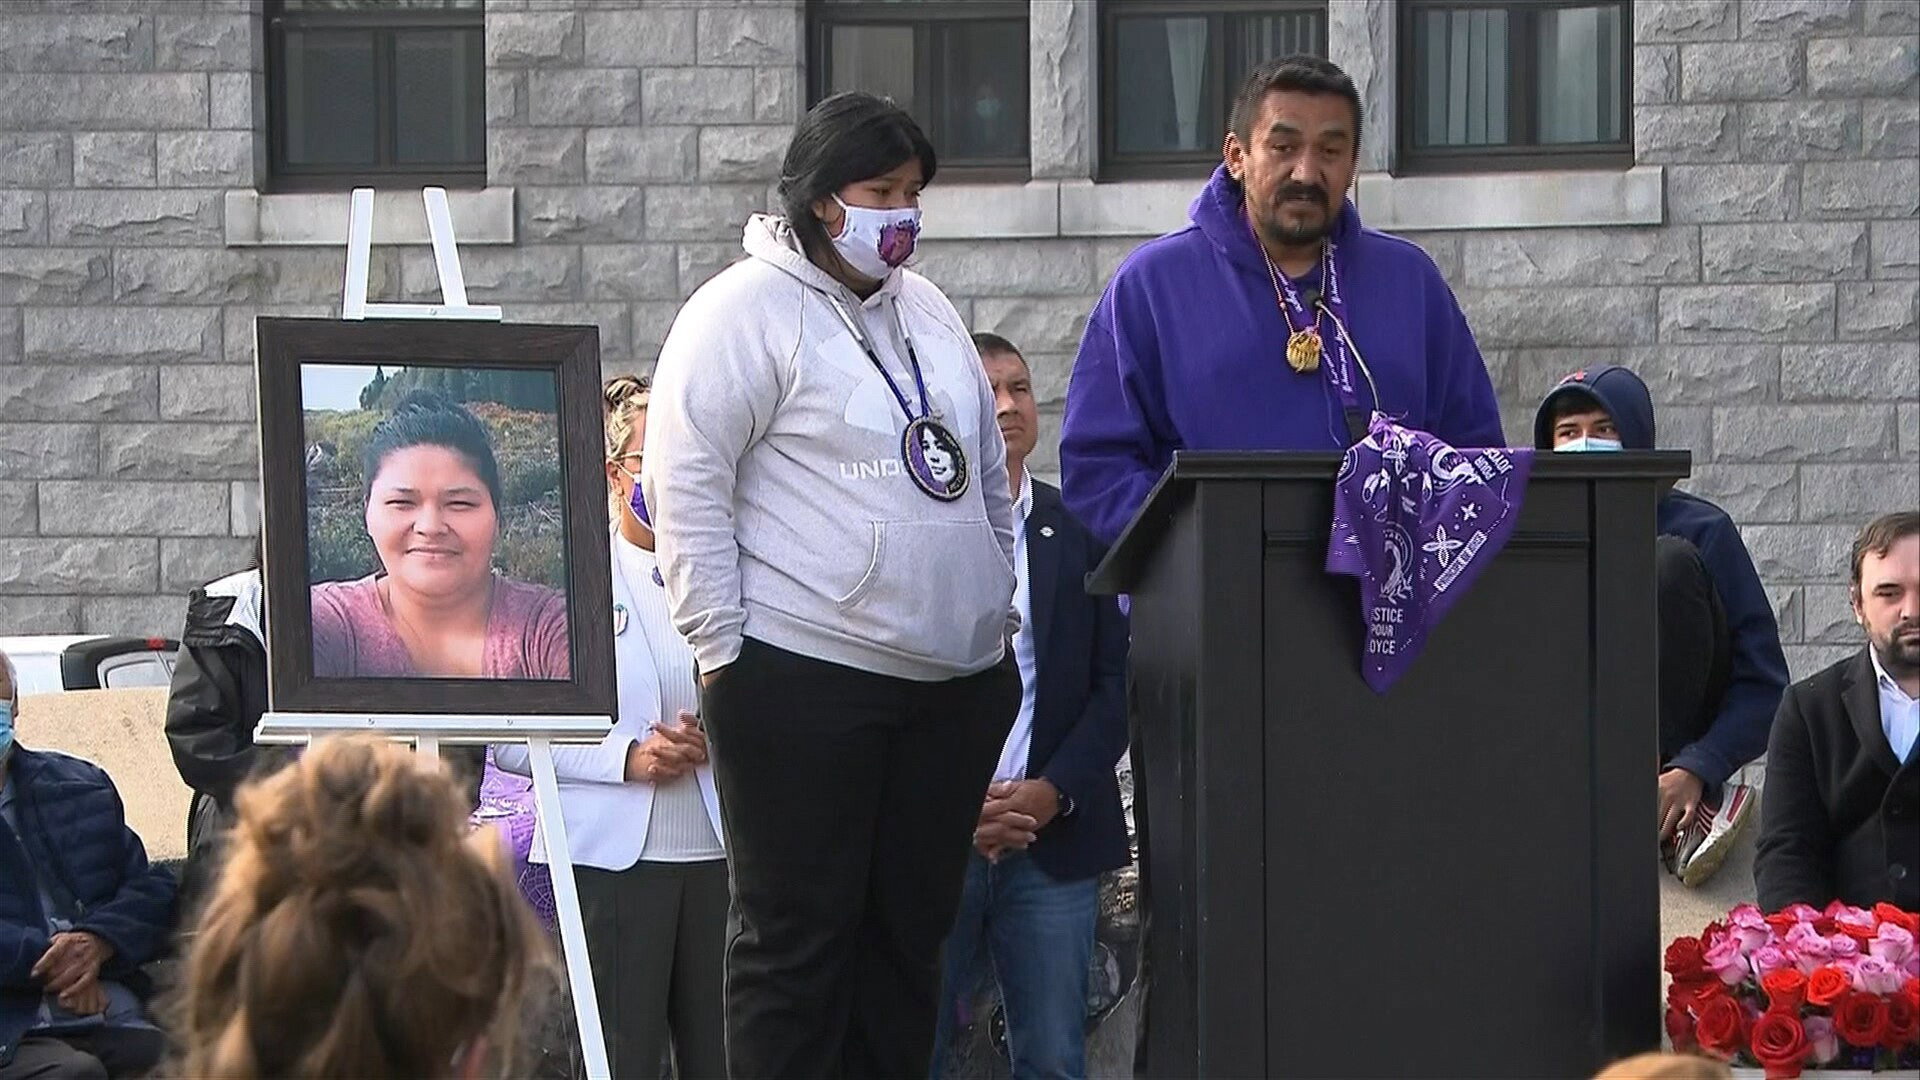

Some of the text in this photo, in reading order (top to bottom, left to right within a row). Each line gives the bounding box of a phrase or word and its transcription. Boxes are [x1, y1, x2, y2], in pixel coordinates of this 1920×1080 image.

[1474, 456, 1496, 480] POUR
[1371, 607, 1403, 623] STICE
[1371, 623, 1393, 637] POUR
[1368, 639, 1396, 654] OYCE
